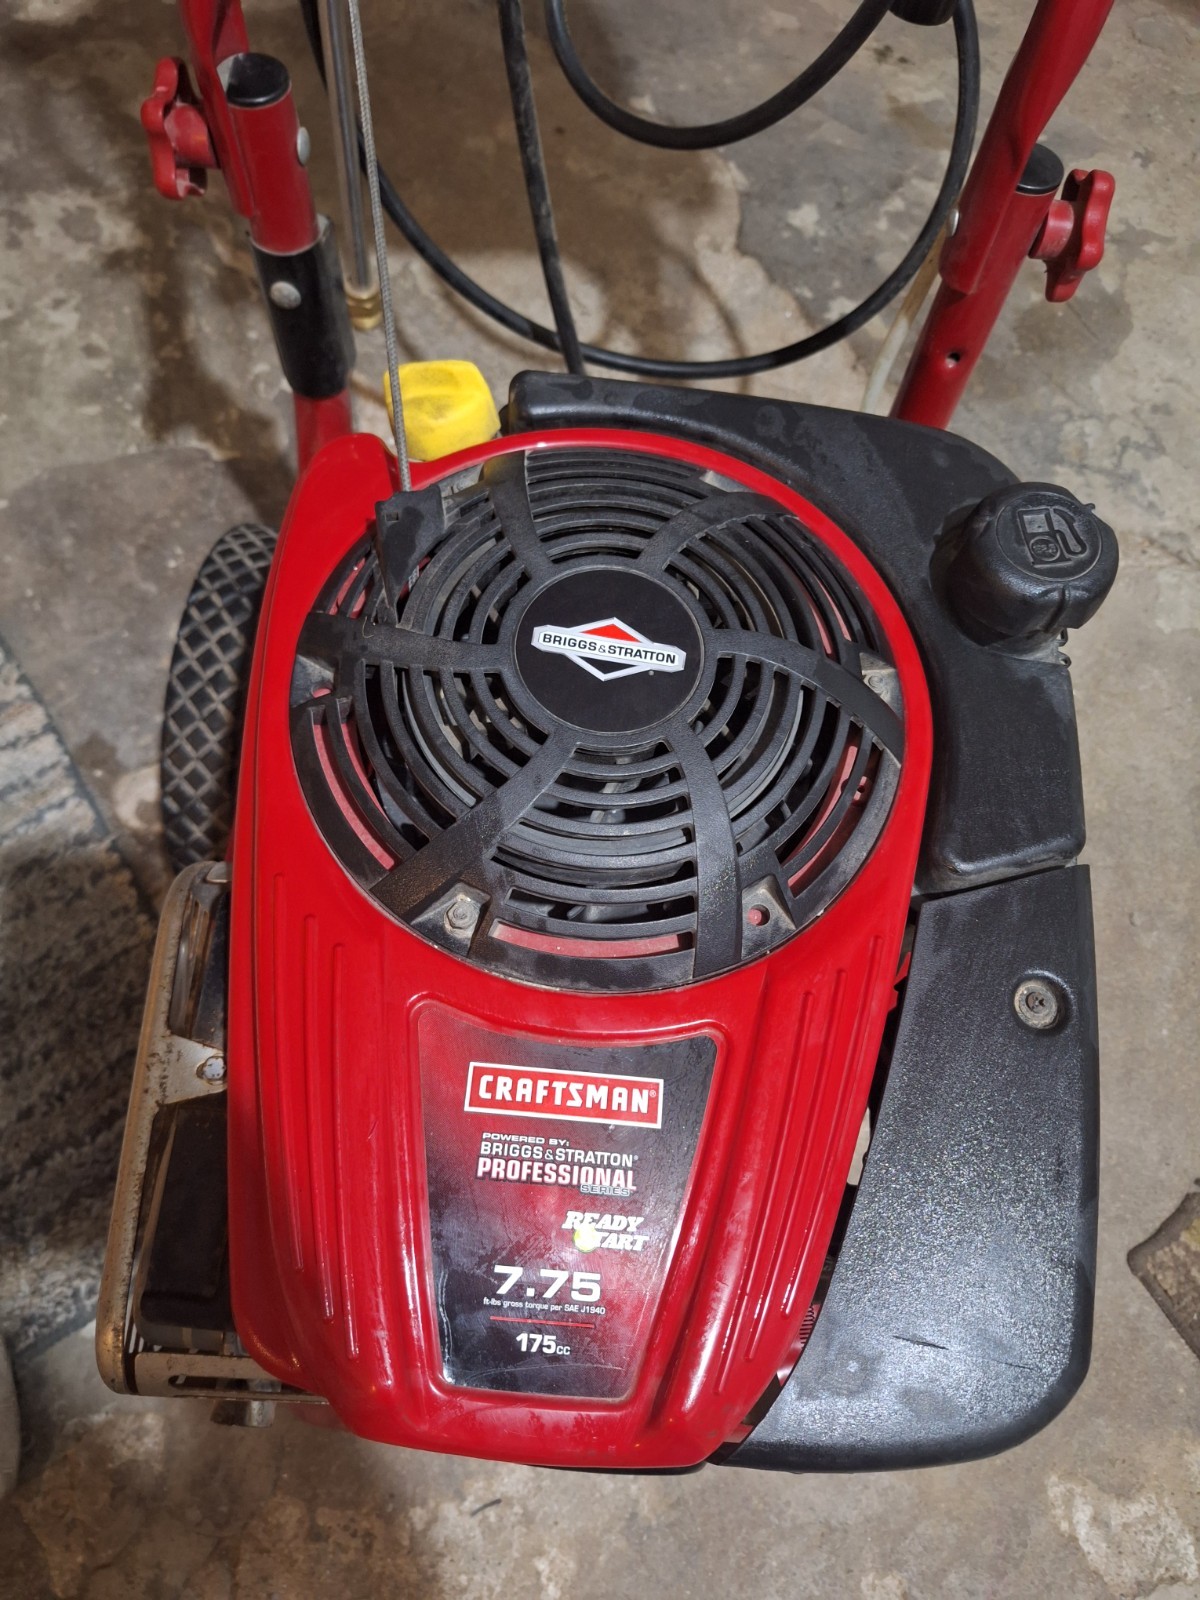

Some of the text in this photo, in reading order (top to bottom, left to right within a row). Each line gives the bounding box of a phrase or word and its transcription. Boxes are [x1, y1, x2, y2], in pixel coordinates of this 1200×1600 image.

[482, 1132, 570, 1147] POWERED BY:
[477, 1158, 637, 1190] PROFESSIONAL
[580, 1184, 630, 1196] SERIES
[561, 1210, 645, 1232] READY
[493, 1264, 601, 1303] 7.75
[503, 1300, 523, 1308] gross
[525, 1301, 549, 1310] torque
[550, 1304, 562, 1312] per
[564, 1304, 579, 1312] SAE
[580, 1305, 606, 1315] J1940
